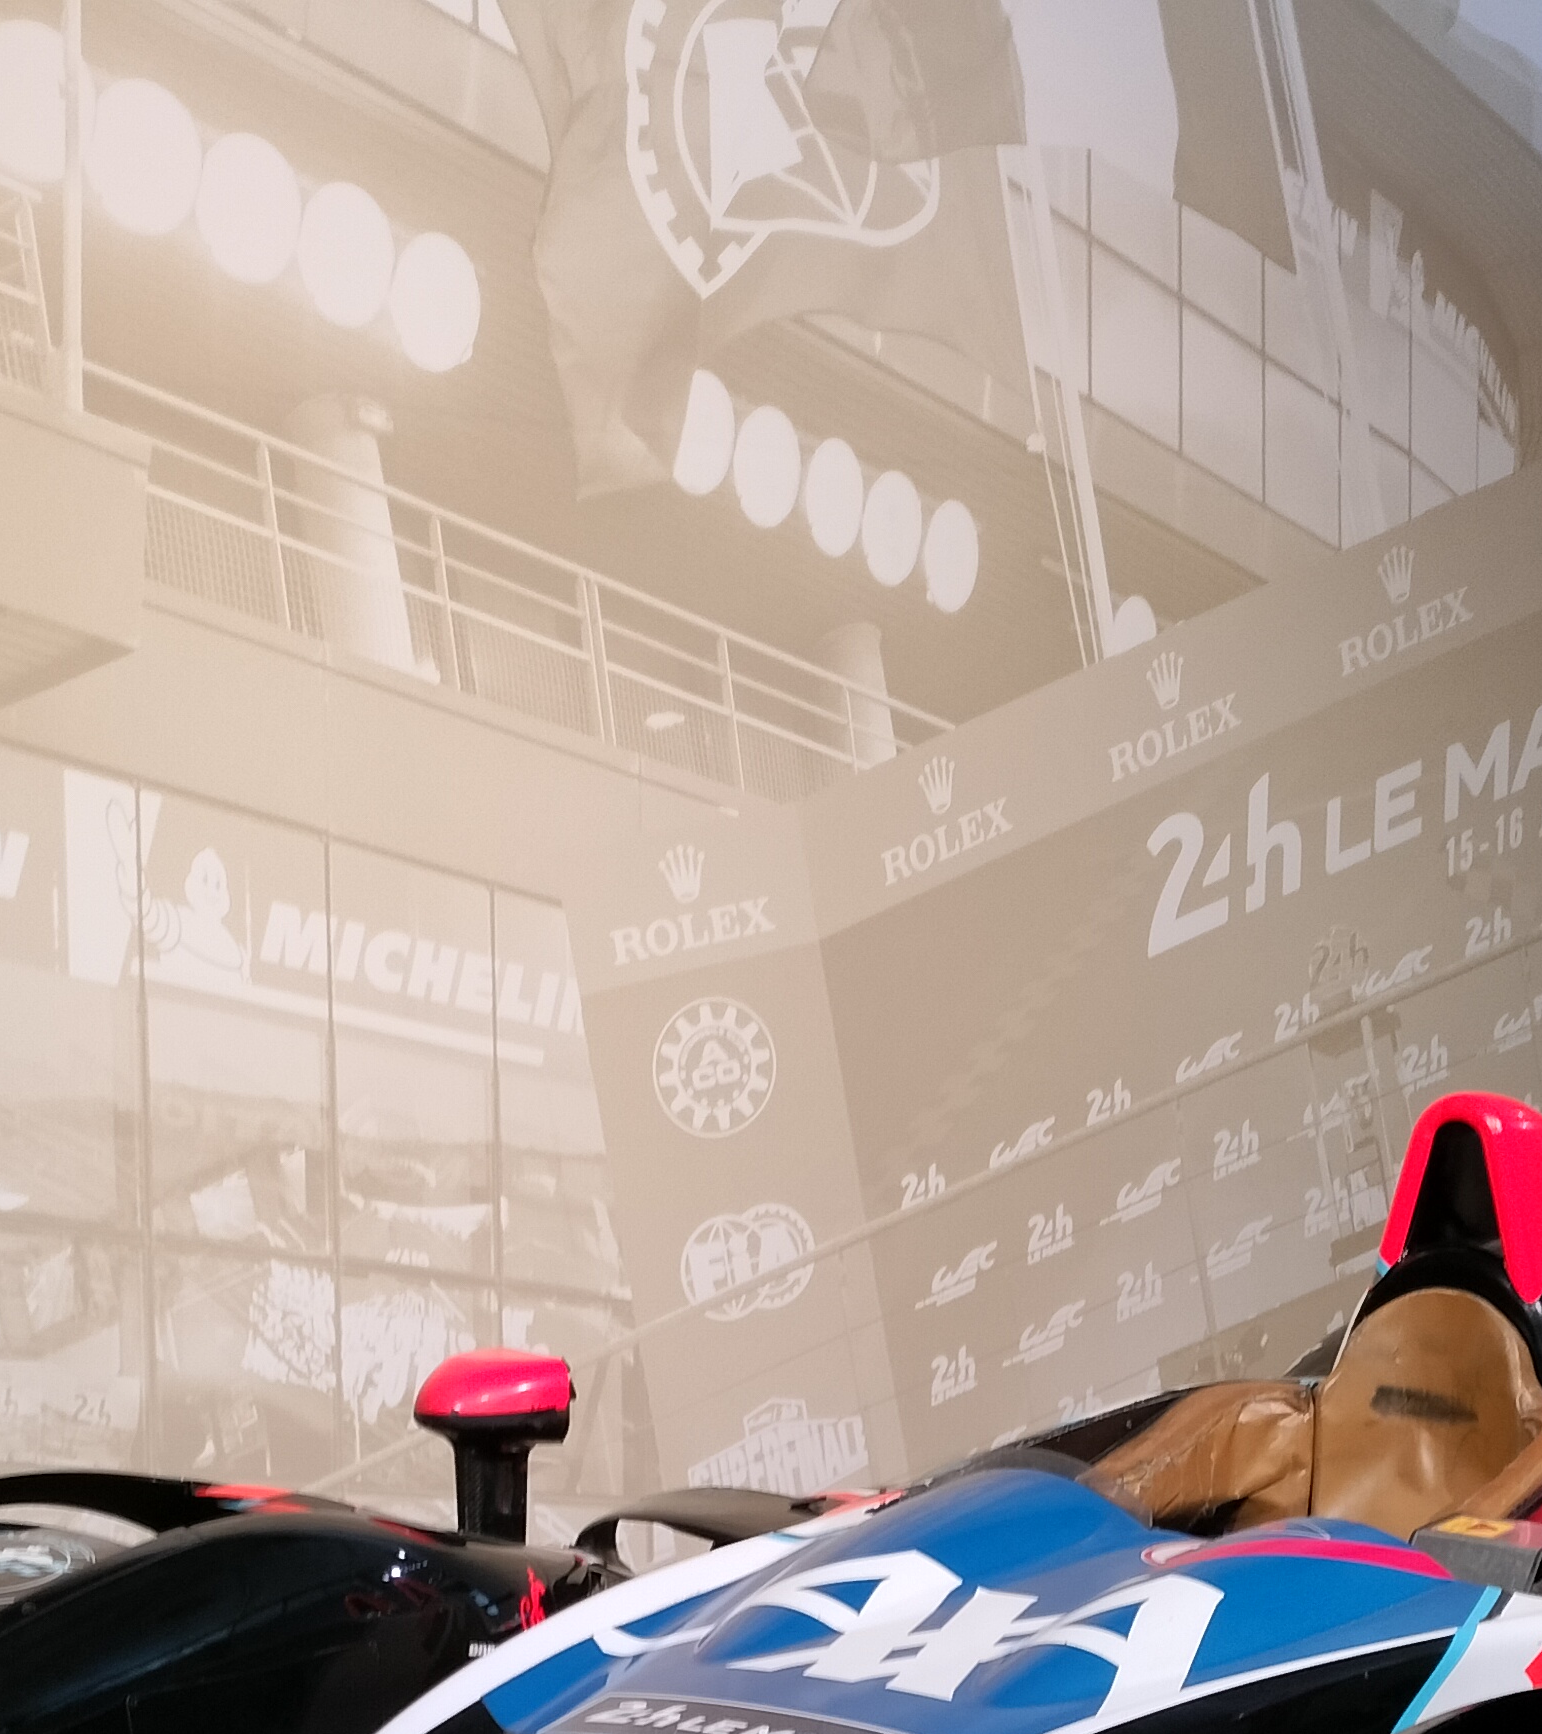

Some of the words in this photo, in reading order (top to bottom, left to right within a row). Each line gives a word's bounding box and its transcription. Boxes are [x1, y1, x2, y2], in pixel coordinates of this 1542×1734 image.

[1338, 586, 1474, 677] ROLEX
[1107, 691, 1243, 782] ROLEX
[881, 797, 1015, 886] ROLEX
[1146, 772, 1302, 958] 24h
[1325, 760, 1423, 875] LE
[612, 897, 775, 966] ROLEX
